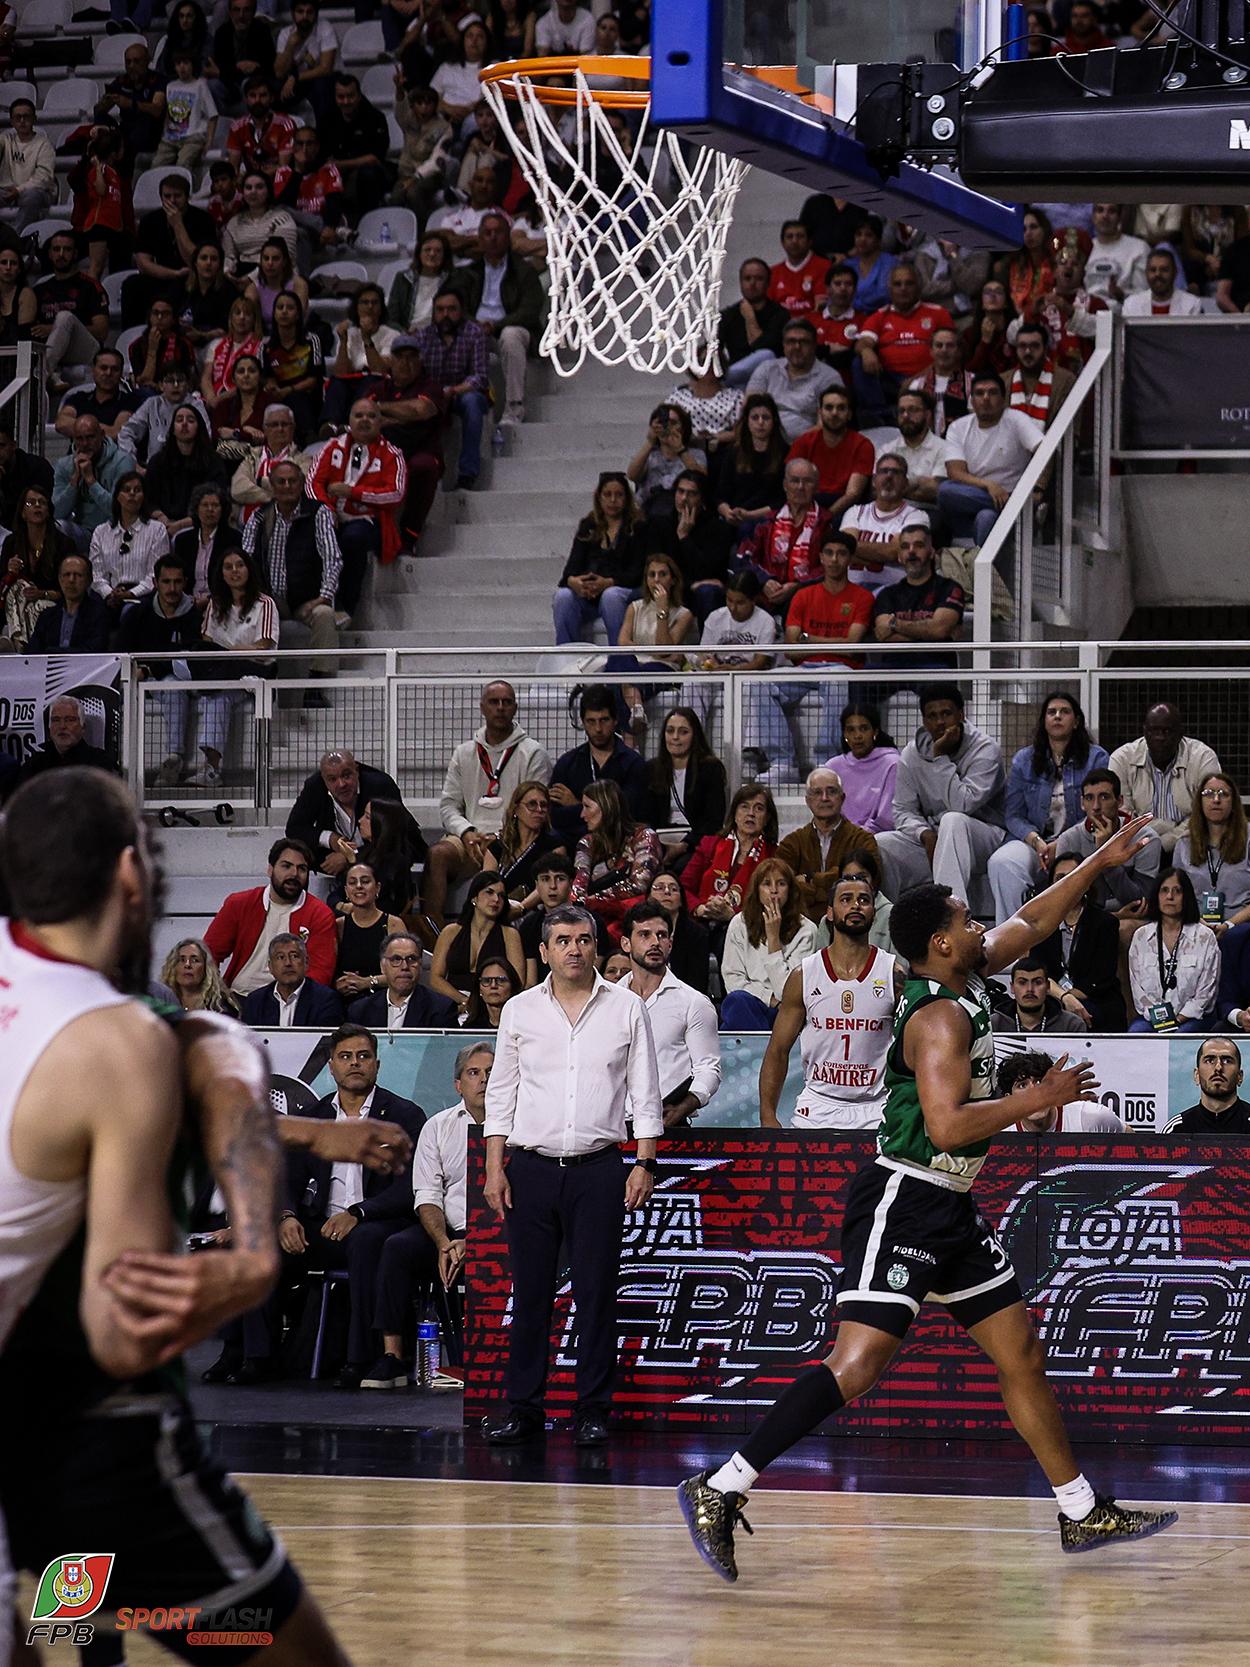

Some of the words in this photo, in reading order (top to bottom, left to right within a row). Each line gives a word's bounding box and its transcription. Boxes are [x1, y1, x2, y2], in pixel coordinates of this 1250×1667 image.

[13, 703, 36, 721] DOS
[825, 1017, 883, 1032] BENFICA
[841, 1033, 851, 1061] 1
[811, 1062, 878, 1087] RAMIREZ
[822, 1060, 869, 1070] conservas
[1125, 1099, 1156, 1122] DOS
[1054, 1204, 1182, 1264] LOJA
